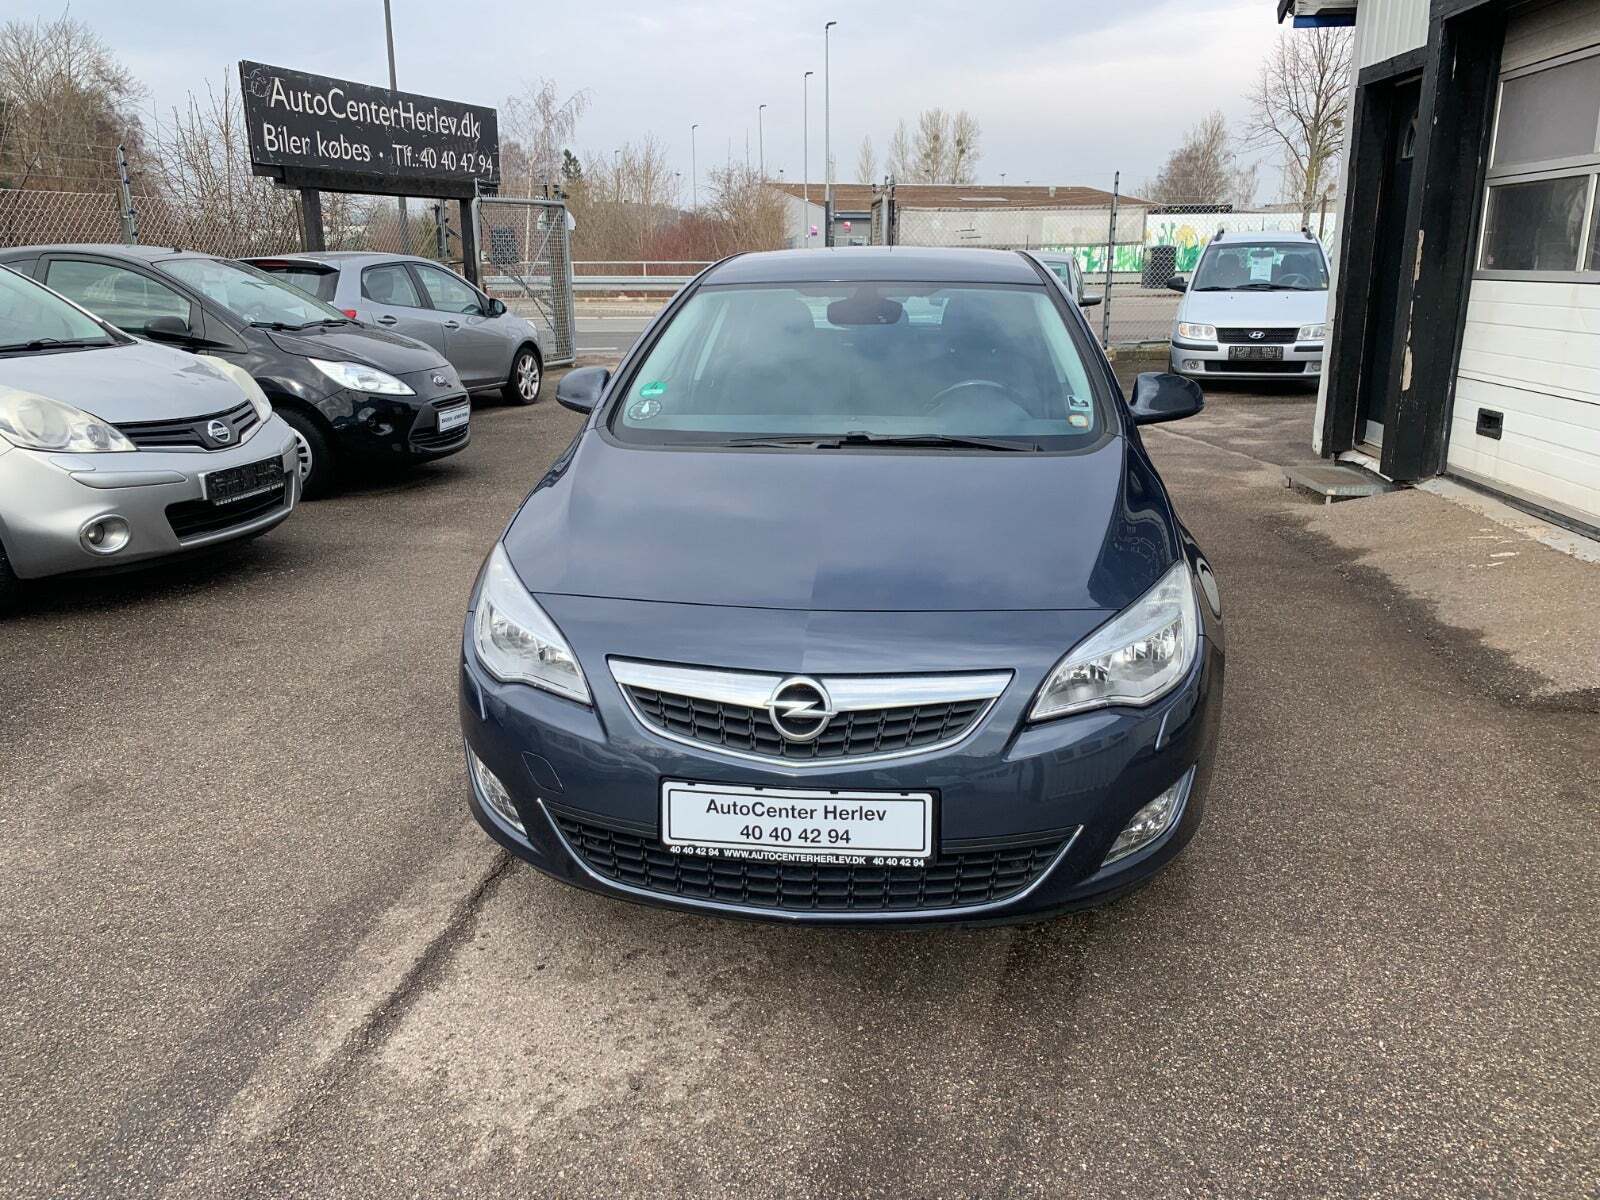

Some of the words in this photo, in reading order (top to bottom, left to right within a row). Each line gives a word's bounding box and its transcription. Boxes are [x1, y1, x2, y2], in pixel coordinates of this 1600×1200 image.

[270, 77, 481, 140] AutoCenterHerlev.dk
[263, 123, 310, 155] Biler
[317, 131, 370, 162] købes
[441, 151, 456, 171] 40
[460, 153, 475, 173] 42
[479, 155, 493, 179] 94
[706, 798, 817, 820] AutoCenter
[824, 805, 887, 822] Herlev
[740, 825, 763, 840] 40
[769, 826, 792, 842] 40
[798, 828, 821, 843] 42
[828, 828, 851, 844] 94
[670, 846, 681, 854] 40
[682, 847, 694, 855] 40
[695, 847, 706, 856] 42
[708, 848, 719, 856] 94
[723, 849, 866, 865] WWW.AUTOCENTERHERLEV.DK
[872, 857, 884, 865] 40
[886, 858, 898, 866] 40
[899, 858, 911, 866] 42
[912, 859, 924, 867] 94
